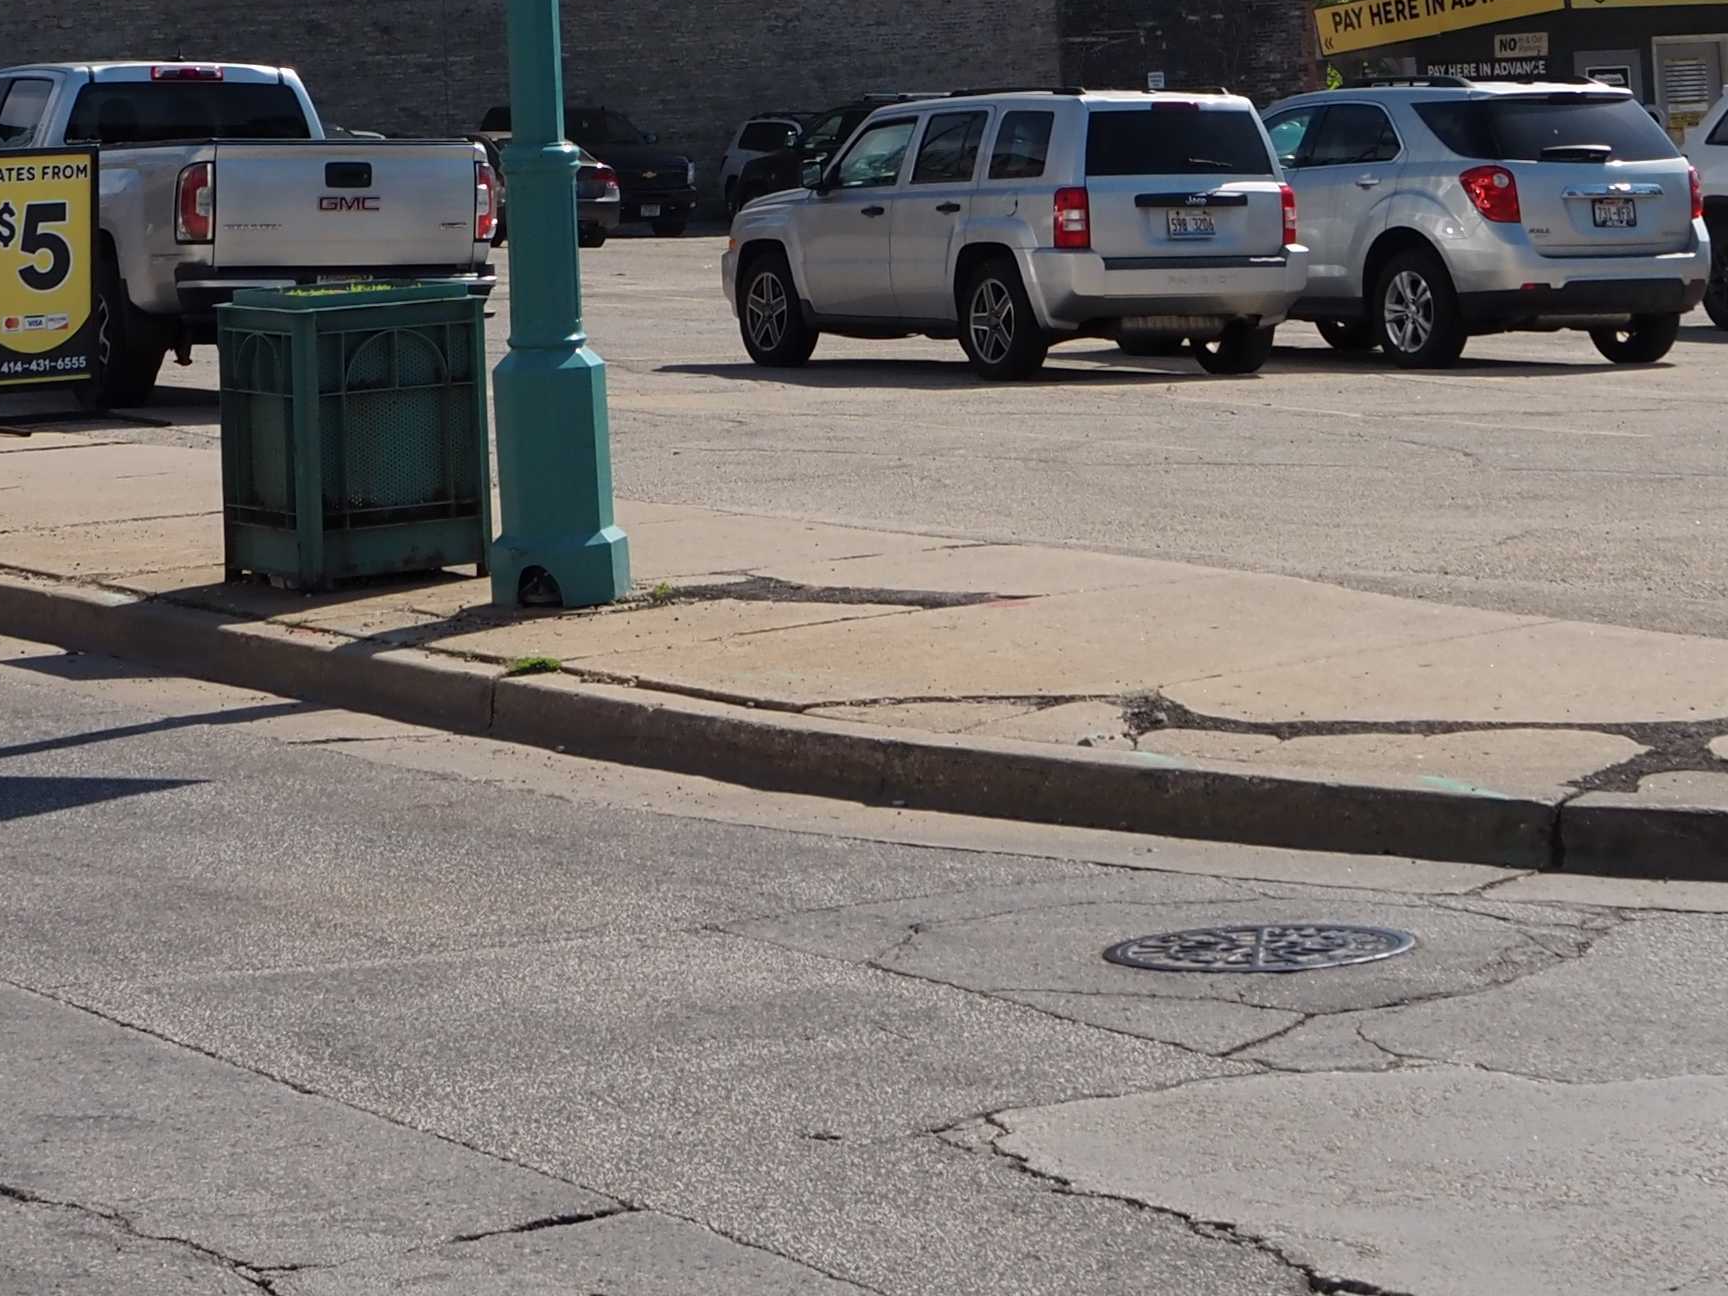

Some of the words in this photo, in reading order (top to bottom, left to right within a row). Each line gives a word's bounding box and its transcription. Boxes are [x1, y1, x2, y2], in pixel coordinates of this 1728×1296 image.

[1332, 7, 1365, 34] PAY
[1499, 37, 1517, 53] NO
[1427, 64, 1446, 77] PAY
[1448, 62, 1478, 78] HERE
[1480, 61, 1491, 76] IN
[1493, 60, 1547, 76] ADVANCE
[41, 164, 89, 180] FROM
[319, 197, 381, 211] GMC
[27, 319, 43, 327] VISA
[0, 356, 87, 373] 414-431-6555
